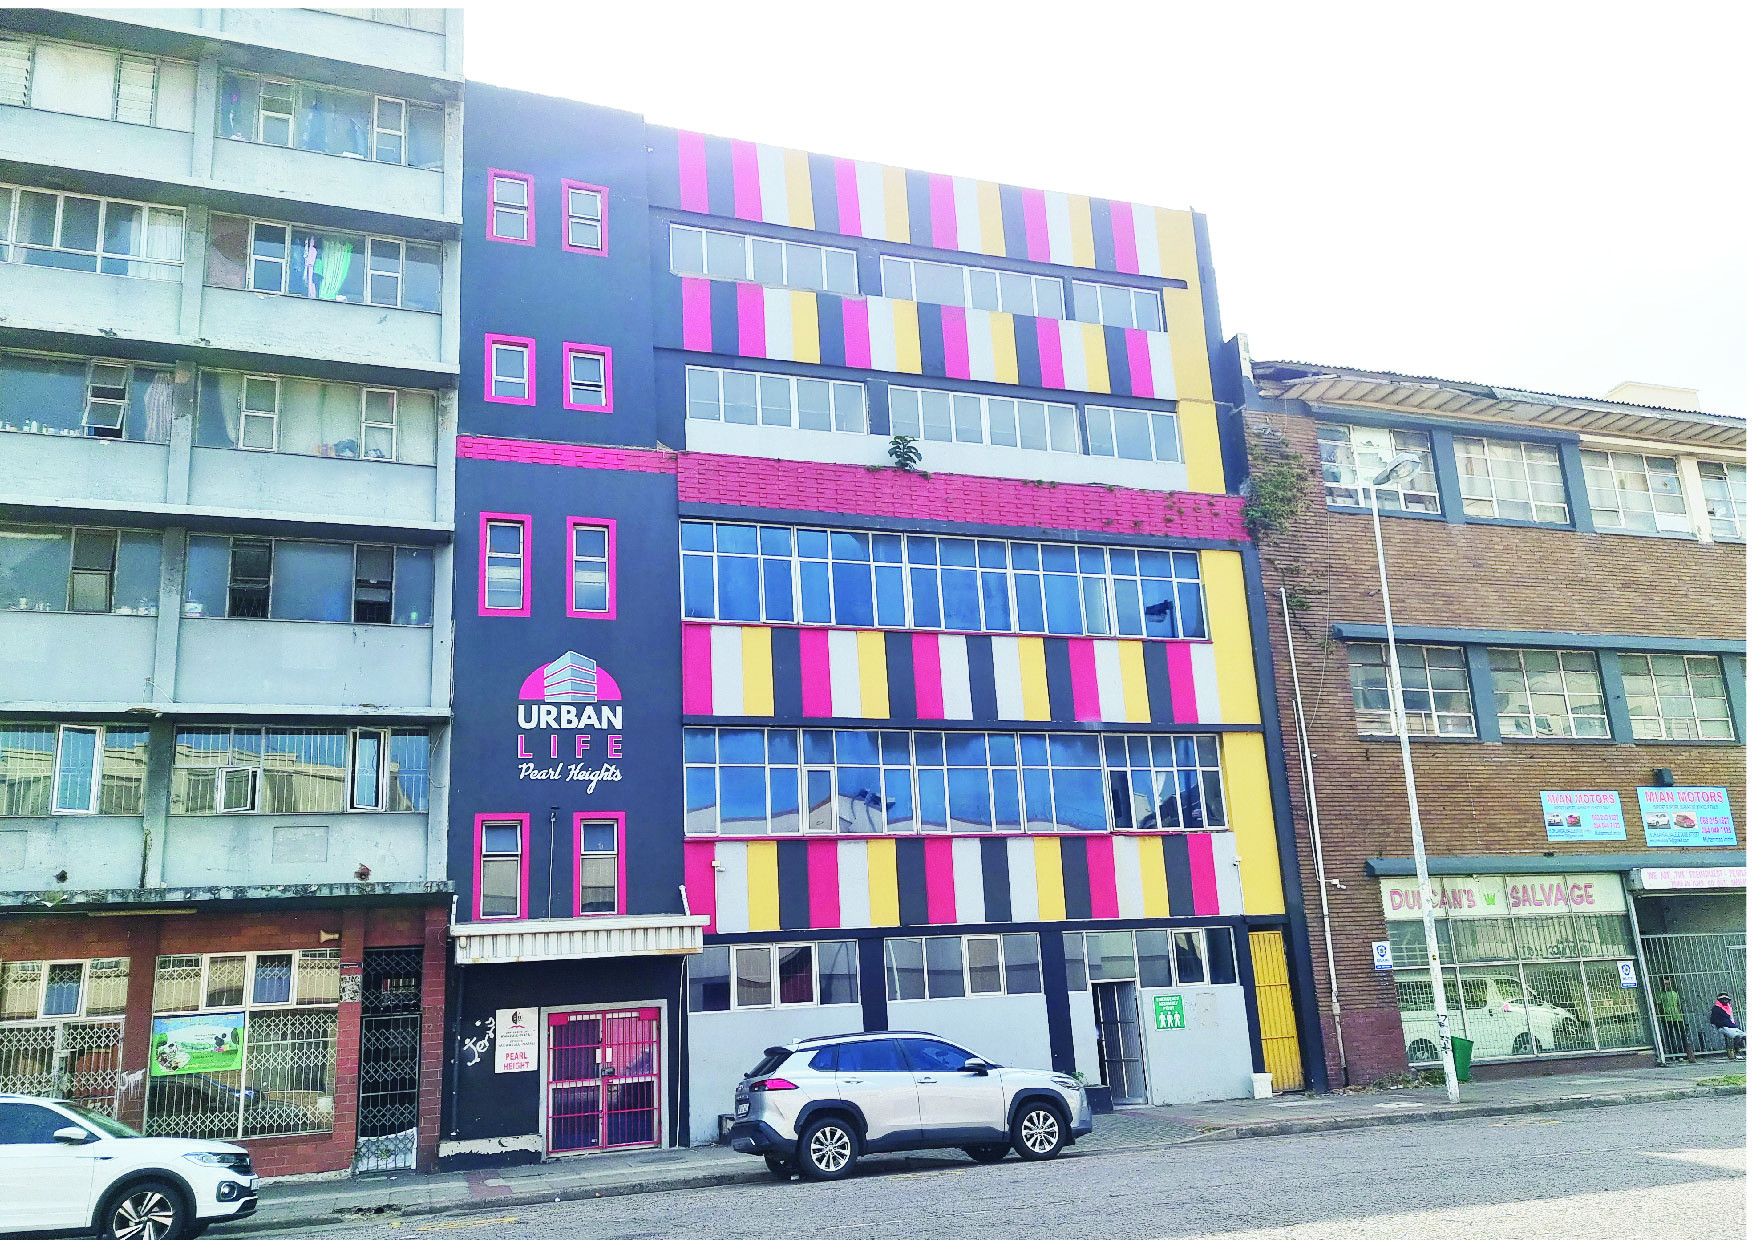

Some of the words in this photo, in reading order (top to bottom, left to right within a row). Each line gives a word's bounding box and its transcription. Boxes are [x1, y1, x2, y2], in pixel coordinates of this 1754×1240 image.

[517, 704, 623, 730] URBAN
[517, 734, 623, 759] LIFE
[518, 762, 564, 780] Pearl
[565, 762, 623, 795] Heights
[1547, 793, 1573, 804] MIAN
[1575, 793, 1616, 805] MOTORS
[1645, 791, 1675, 803] MIAN
[1676, 791, 1724, 803] MOTORS
[1509, 883, 1596, 908] SALVAGE
[505, 1051, 528, 1061] PEARL
[503, 1061, 530, 1071] HEIGHT
